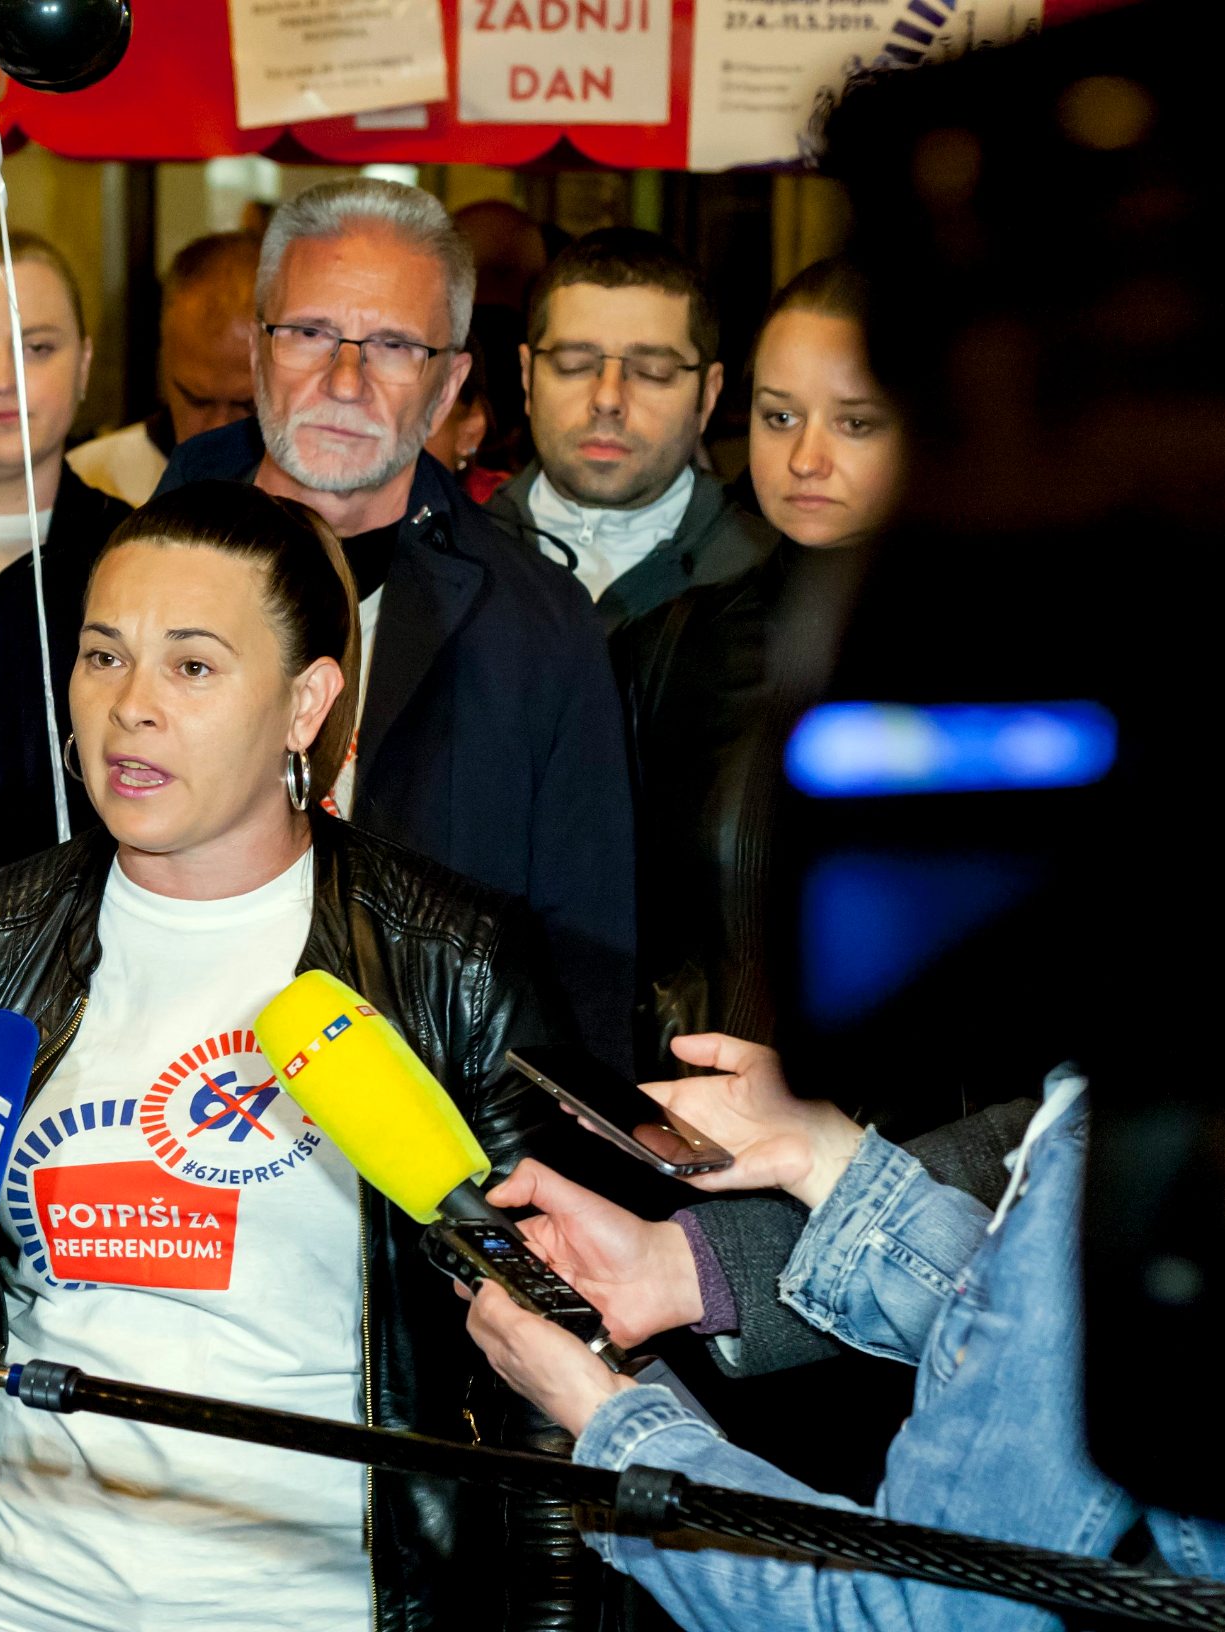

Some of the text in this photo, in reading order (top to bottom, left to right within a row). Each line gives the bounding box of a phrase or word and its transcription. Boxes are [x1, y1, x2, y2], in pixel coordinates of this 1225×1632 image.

[476, 0, 650, 32] ZADNJI
[509, 64, 614, 102] DAN
[189, 1070, 280, 1142] 67
[181, 1132, 322, 1185] #67JEPREVIŠE
[48, 1197, 220, 1230] POTPIŠI ZA
[54, 1237, 222, 1260] REFERENDUM!
